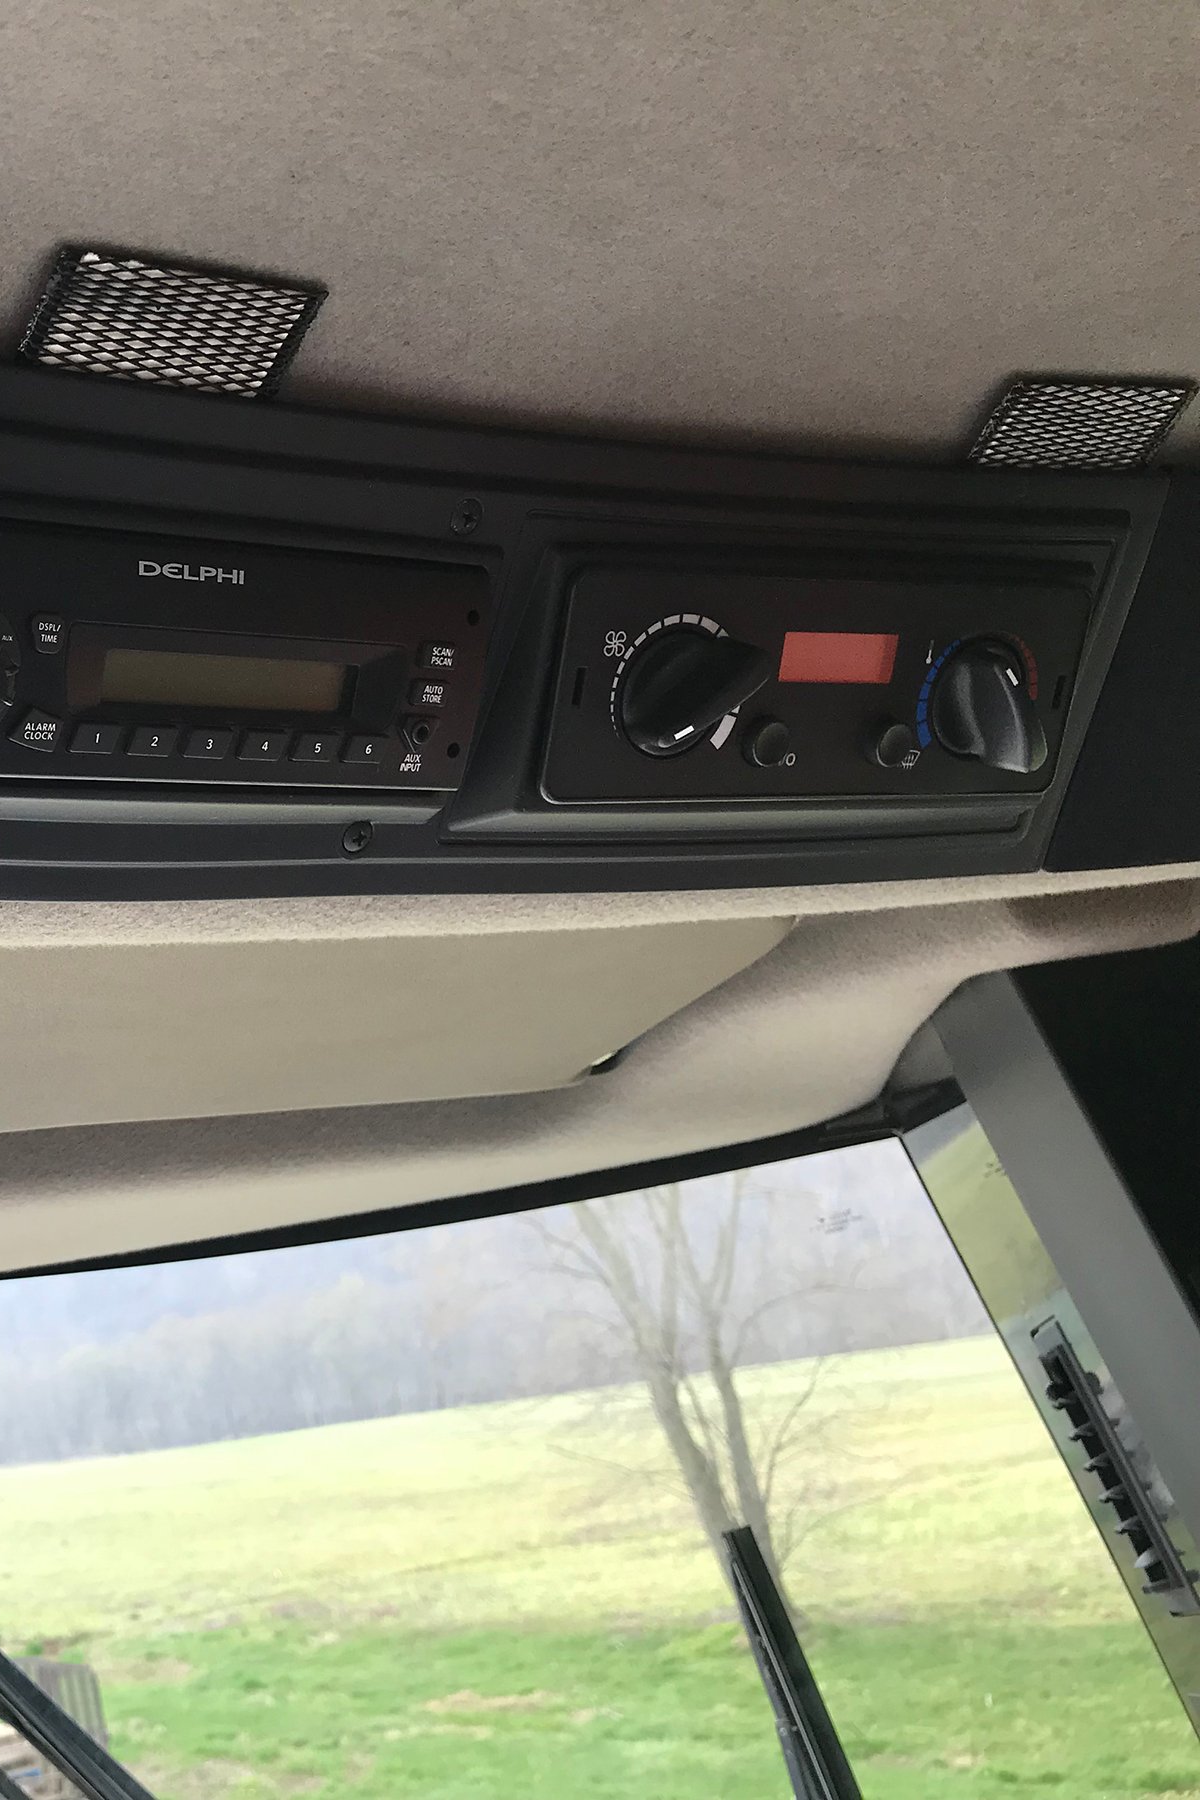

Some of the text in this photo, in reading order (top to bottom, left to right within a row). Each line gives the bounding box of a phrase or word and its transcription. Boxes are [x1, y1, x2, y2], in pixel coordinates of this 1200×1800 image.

[138, 560, 245, 585] DELPHI
[38, 622, 61, 632] DSPL/
[41, 633, 58, 643] TIME
[432, 647, 455, 657] SCAN/
[430, 656, 453, 667] PSCAN
[423, 685, 443, 695] AUTO
[421, 694, 442, 704] STORE
[24, 722, 56, 732] ALARM
[23, 731, 54, 741] CLOCK
[94, 732, 373, 755] 1 2 3 4 5 6
[404, 753, 421, 763] AUX
[399, 763, 421, 772] INPUT
